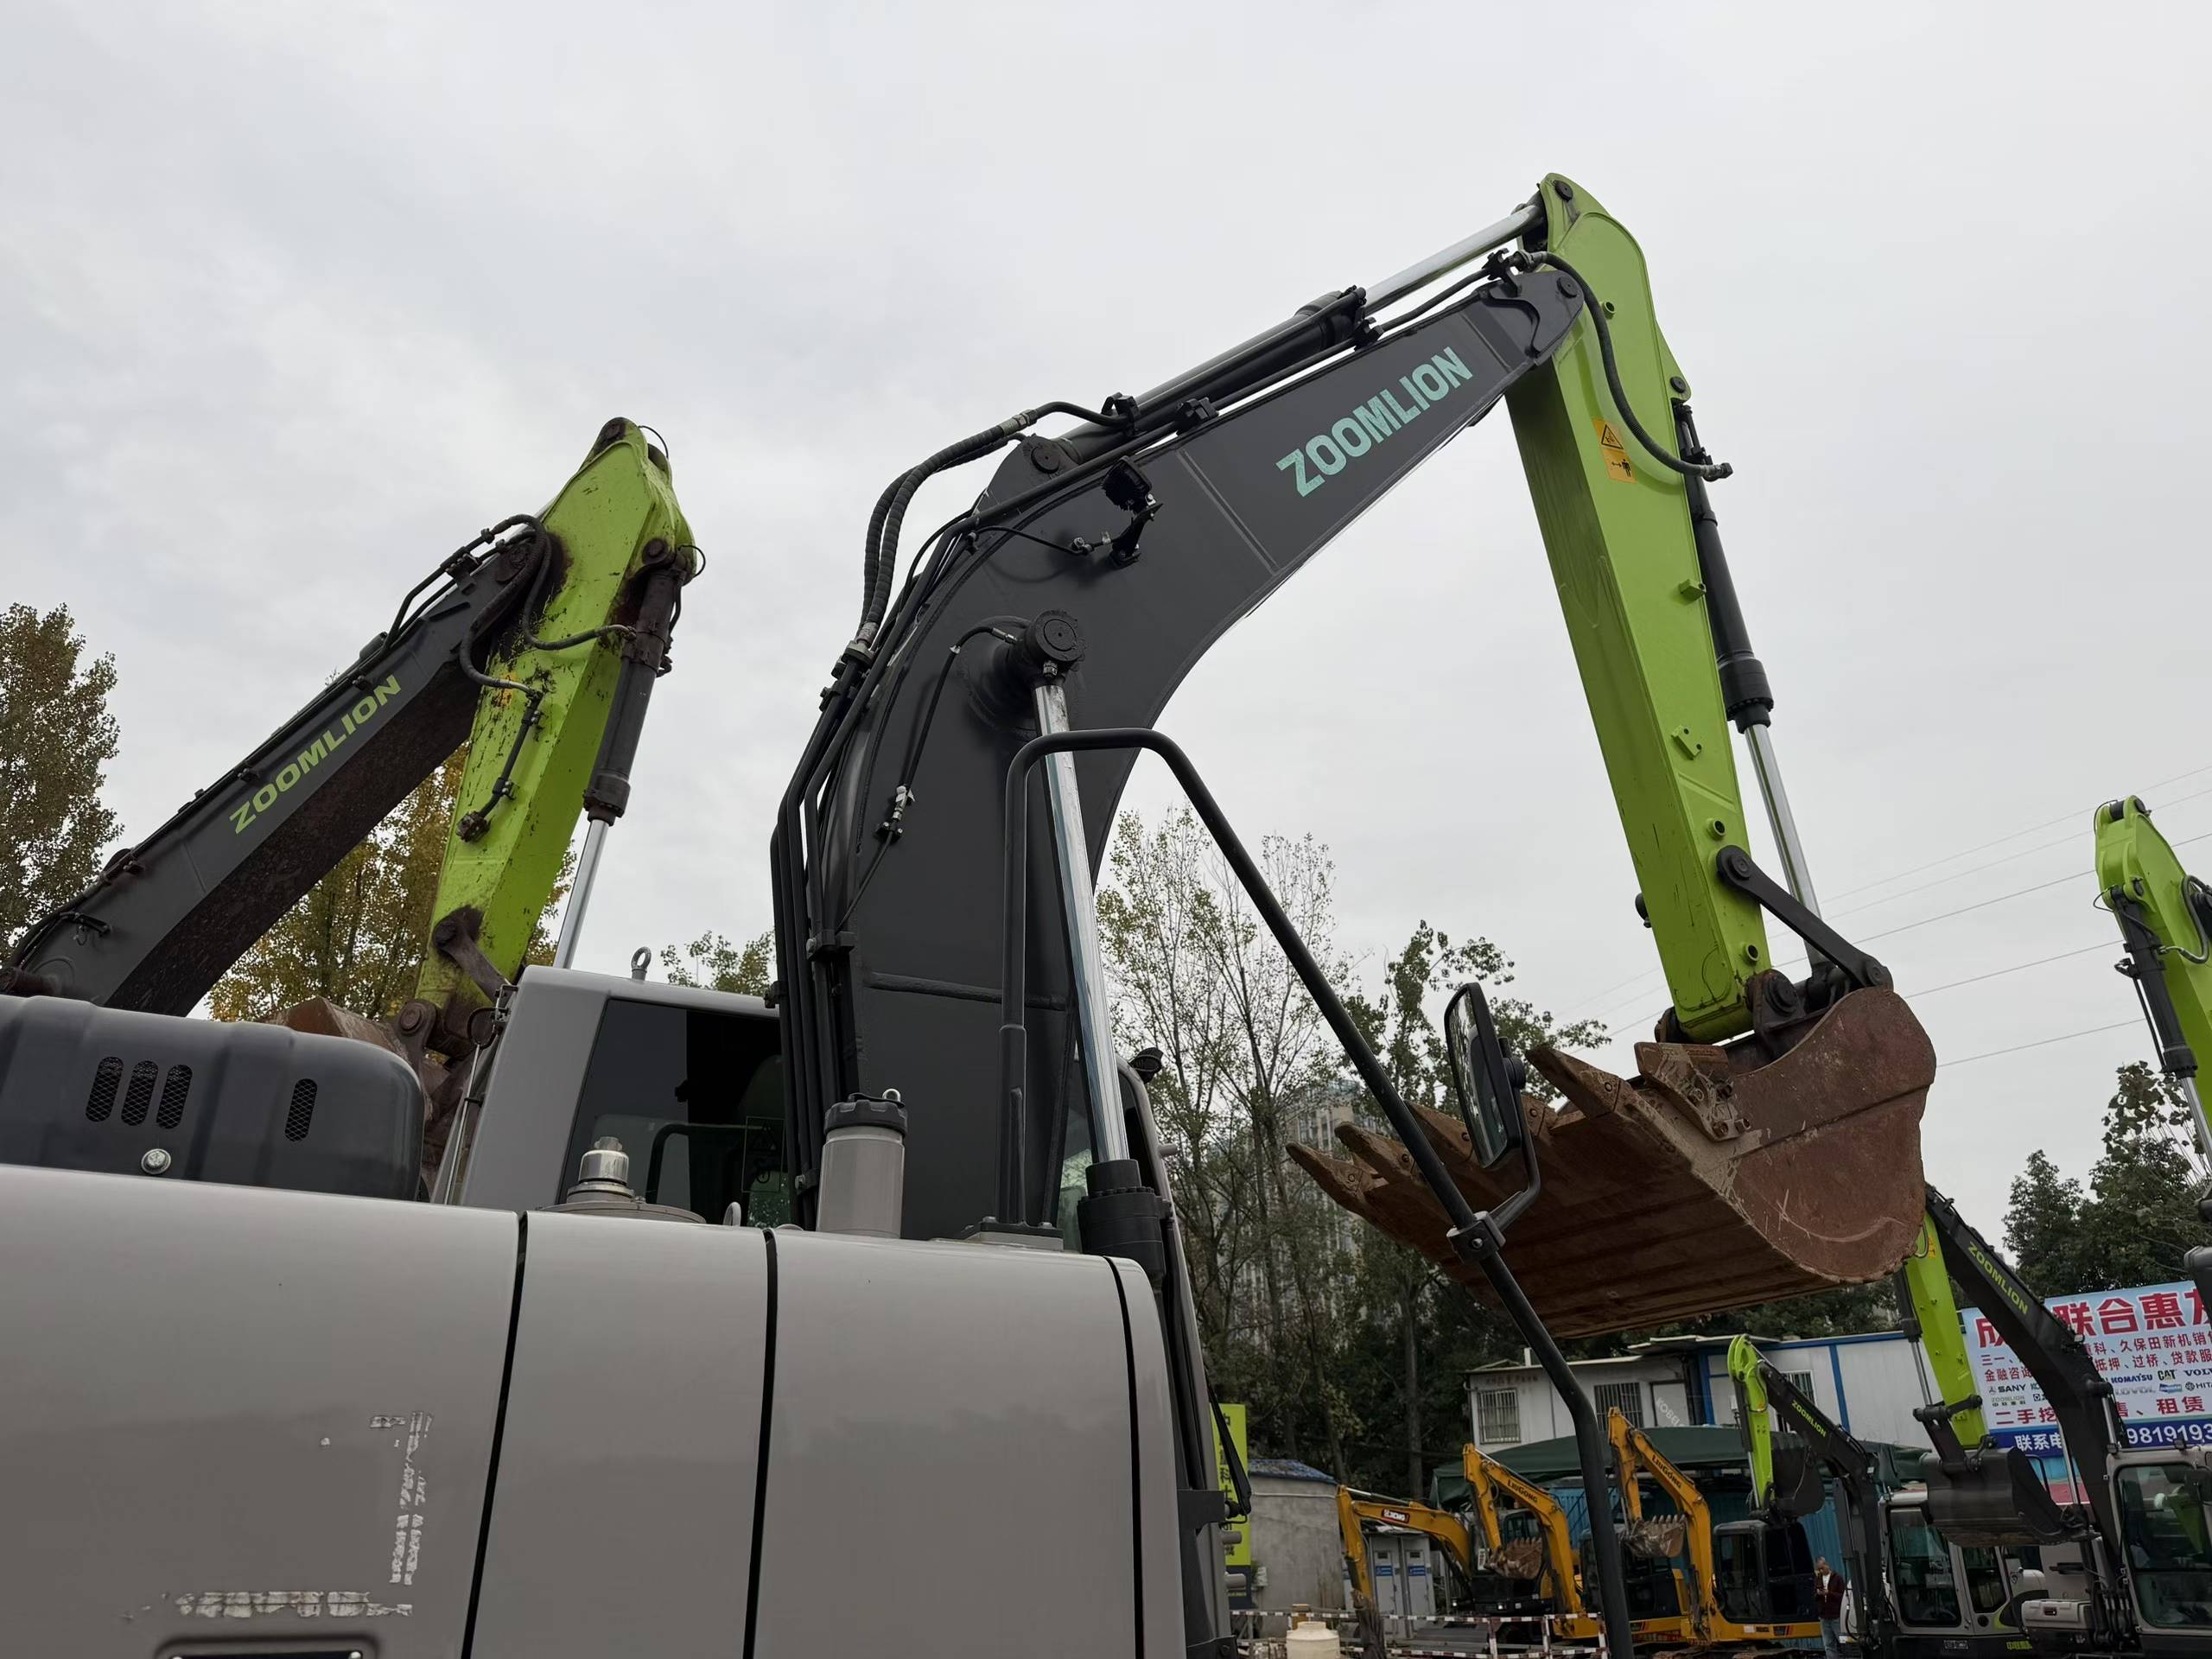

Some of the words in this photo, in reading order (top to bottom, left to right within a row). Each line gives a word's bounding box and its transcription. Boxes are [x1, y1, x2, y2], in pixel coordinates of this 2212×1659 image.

[1275, 346, 1473, 498] ZOOMLION
[229, 674, 402, 835] ZOOMLION
[1968, 1242, 2029, 1315] ZOOMLION
[1998, 1383, 2026, 1393] SANY
[2111, 1373, 2153, 1383] KOMATSU
[2158, 1369, 2176, 1381] CAT
[1791, 1399, 1827, 1437] ZOOMLION
